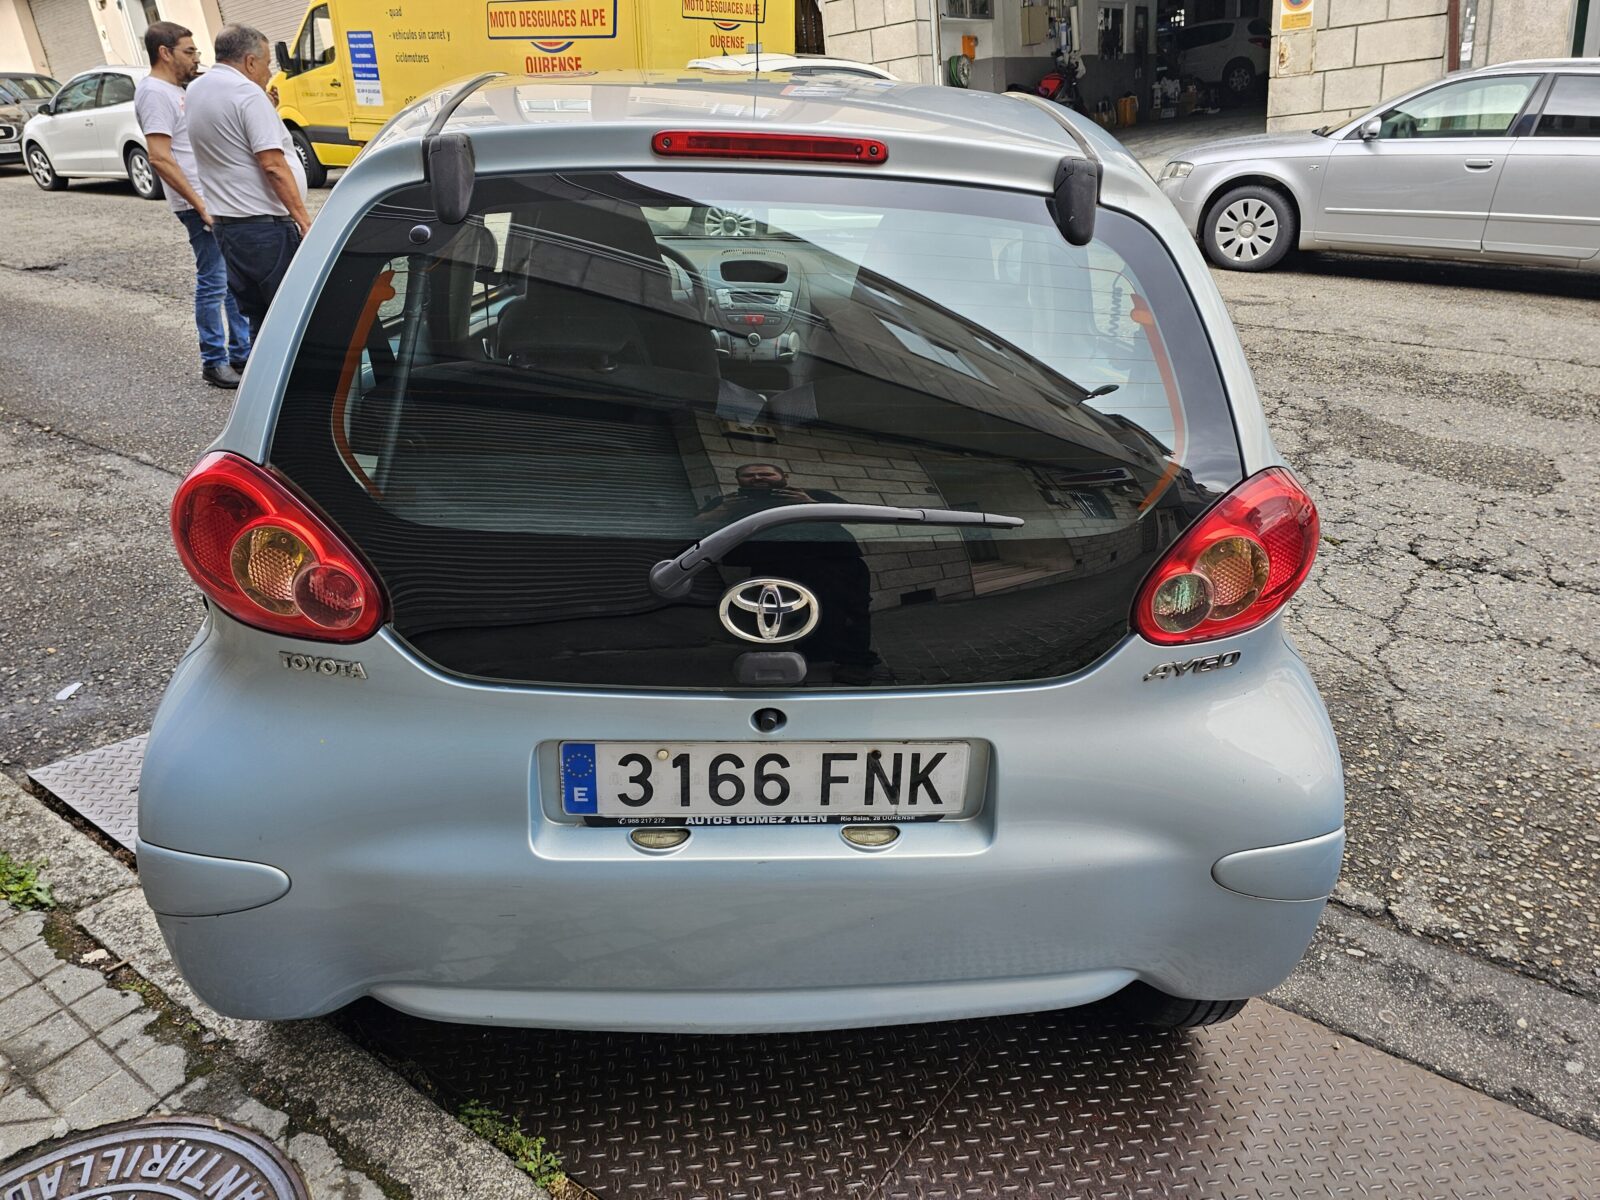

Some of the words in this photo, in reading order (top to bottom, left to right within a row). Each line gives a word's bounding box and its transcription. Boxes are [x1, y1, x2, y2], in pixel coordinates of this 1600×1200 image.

[684, 0, 704, 11] MOTO
[706, 0, 744, 14] DESGUACES
[489, 11, 517, 28] MOTO
[519, 9, 577, 28] DESGUACES
[580, 8, 606, 26] ALPE
[418, 29, 427, 40] sin
[709, 34, 745, 49] OURENSE
[525, 55, 583, 73] OURENSE
[279, 650, 368, 680] TOYOTA
[1142, 649, 1242, 682] AYGO
[617, 752, 792, 807] 3166
[820, 752, 948, 806] FNK
[573, 787, 589, 802] E
[685, 816, 732, 825] AUTOS
[737, 815, 786, 824] GOMEZ
[790, 815, 828, 823] ALEN
